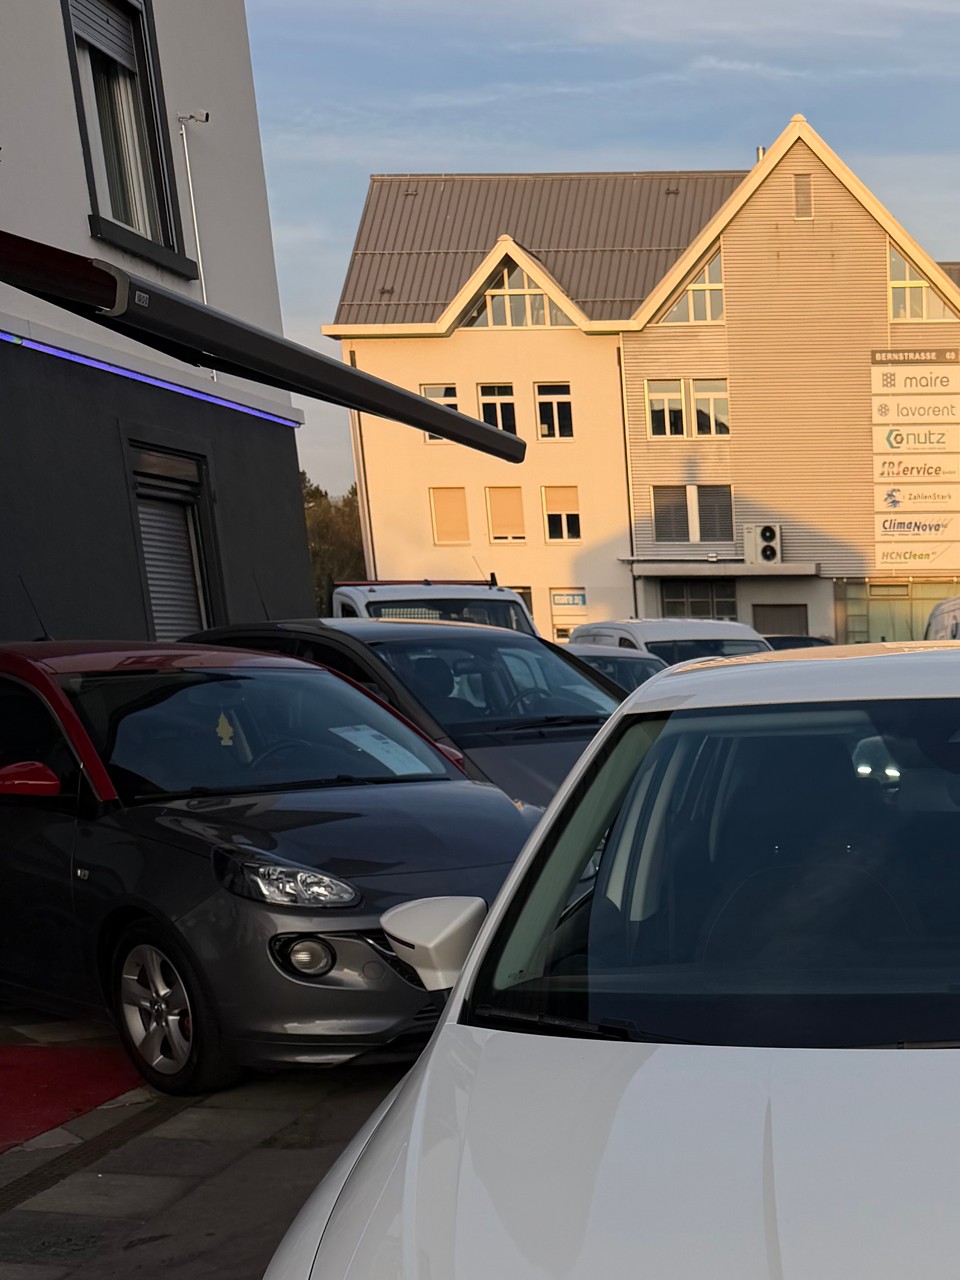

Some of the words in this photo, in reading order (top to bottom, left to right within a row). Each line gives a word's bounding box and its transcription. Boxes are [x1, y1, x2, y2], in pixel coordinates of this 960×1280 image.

[875, 352, 937, 361] BERNSTRASSE
[904, 371, 950, 388] maire
[896, 402, 956, 417] lavorent
